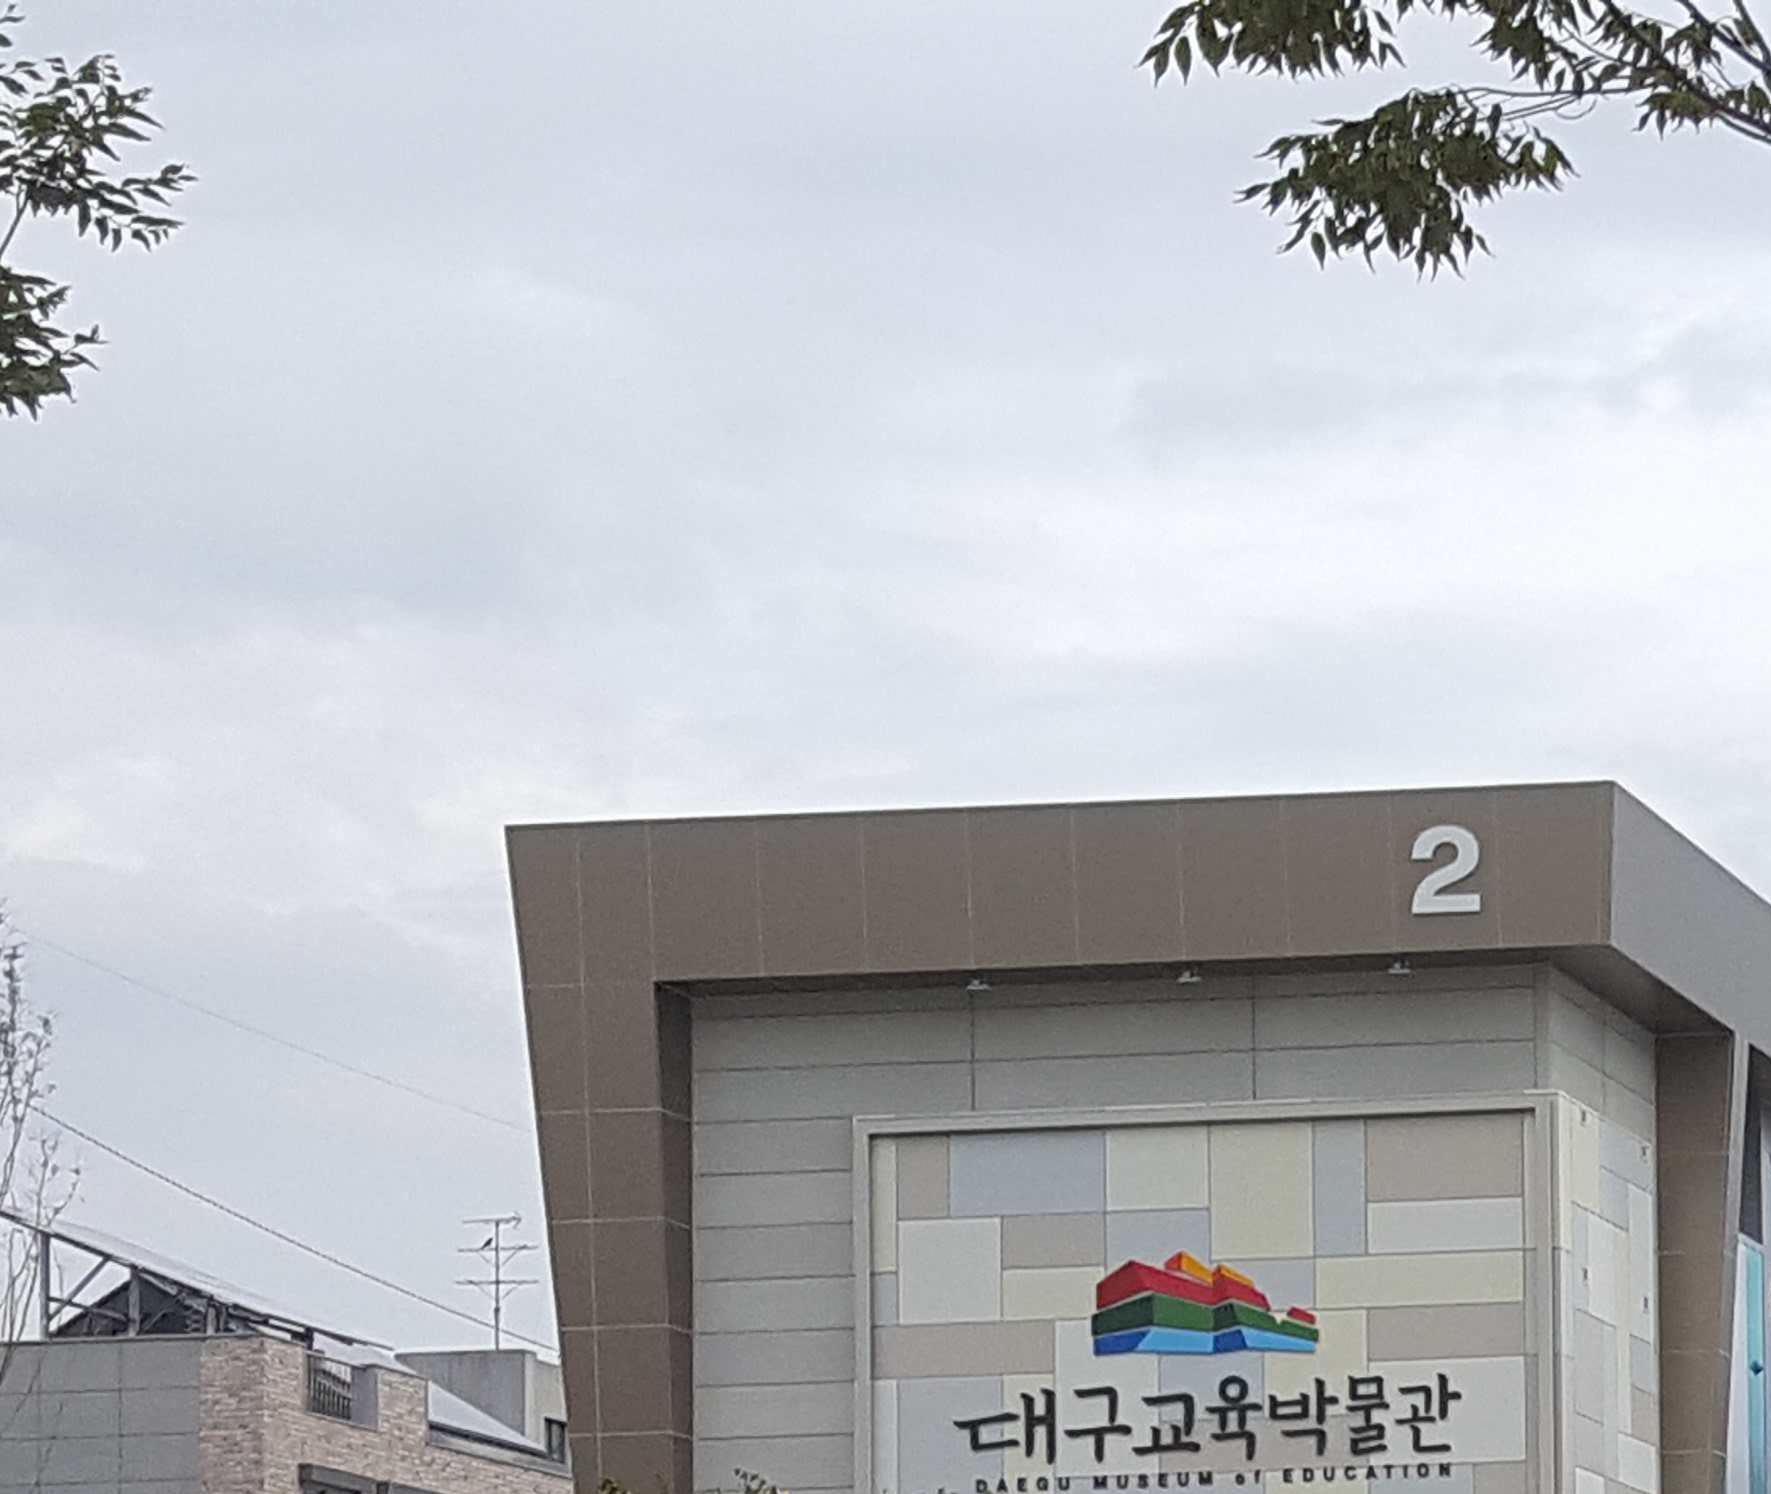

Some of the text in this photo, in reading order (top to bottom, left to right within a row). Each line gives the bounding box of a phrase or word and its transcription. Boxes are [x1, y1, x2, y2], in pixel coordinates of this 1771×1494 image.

[1411, 825, 1481, 914] 2
[953, 1371, 1463, 1465] 대구교육박물관
[976, 1462, 1451, 1493] DAEGU MUSEUM of EDUCATION
